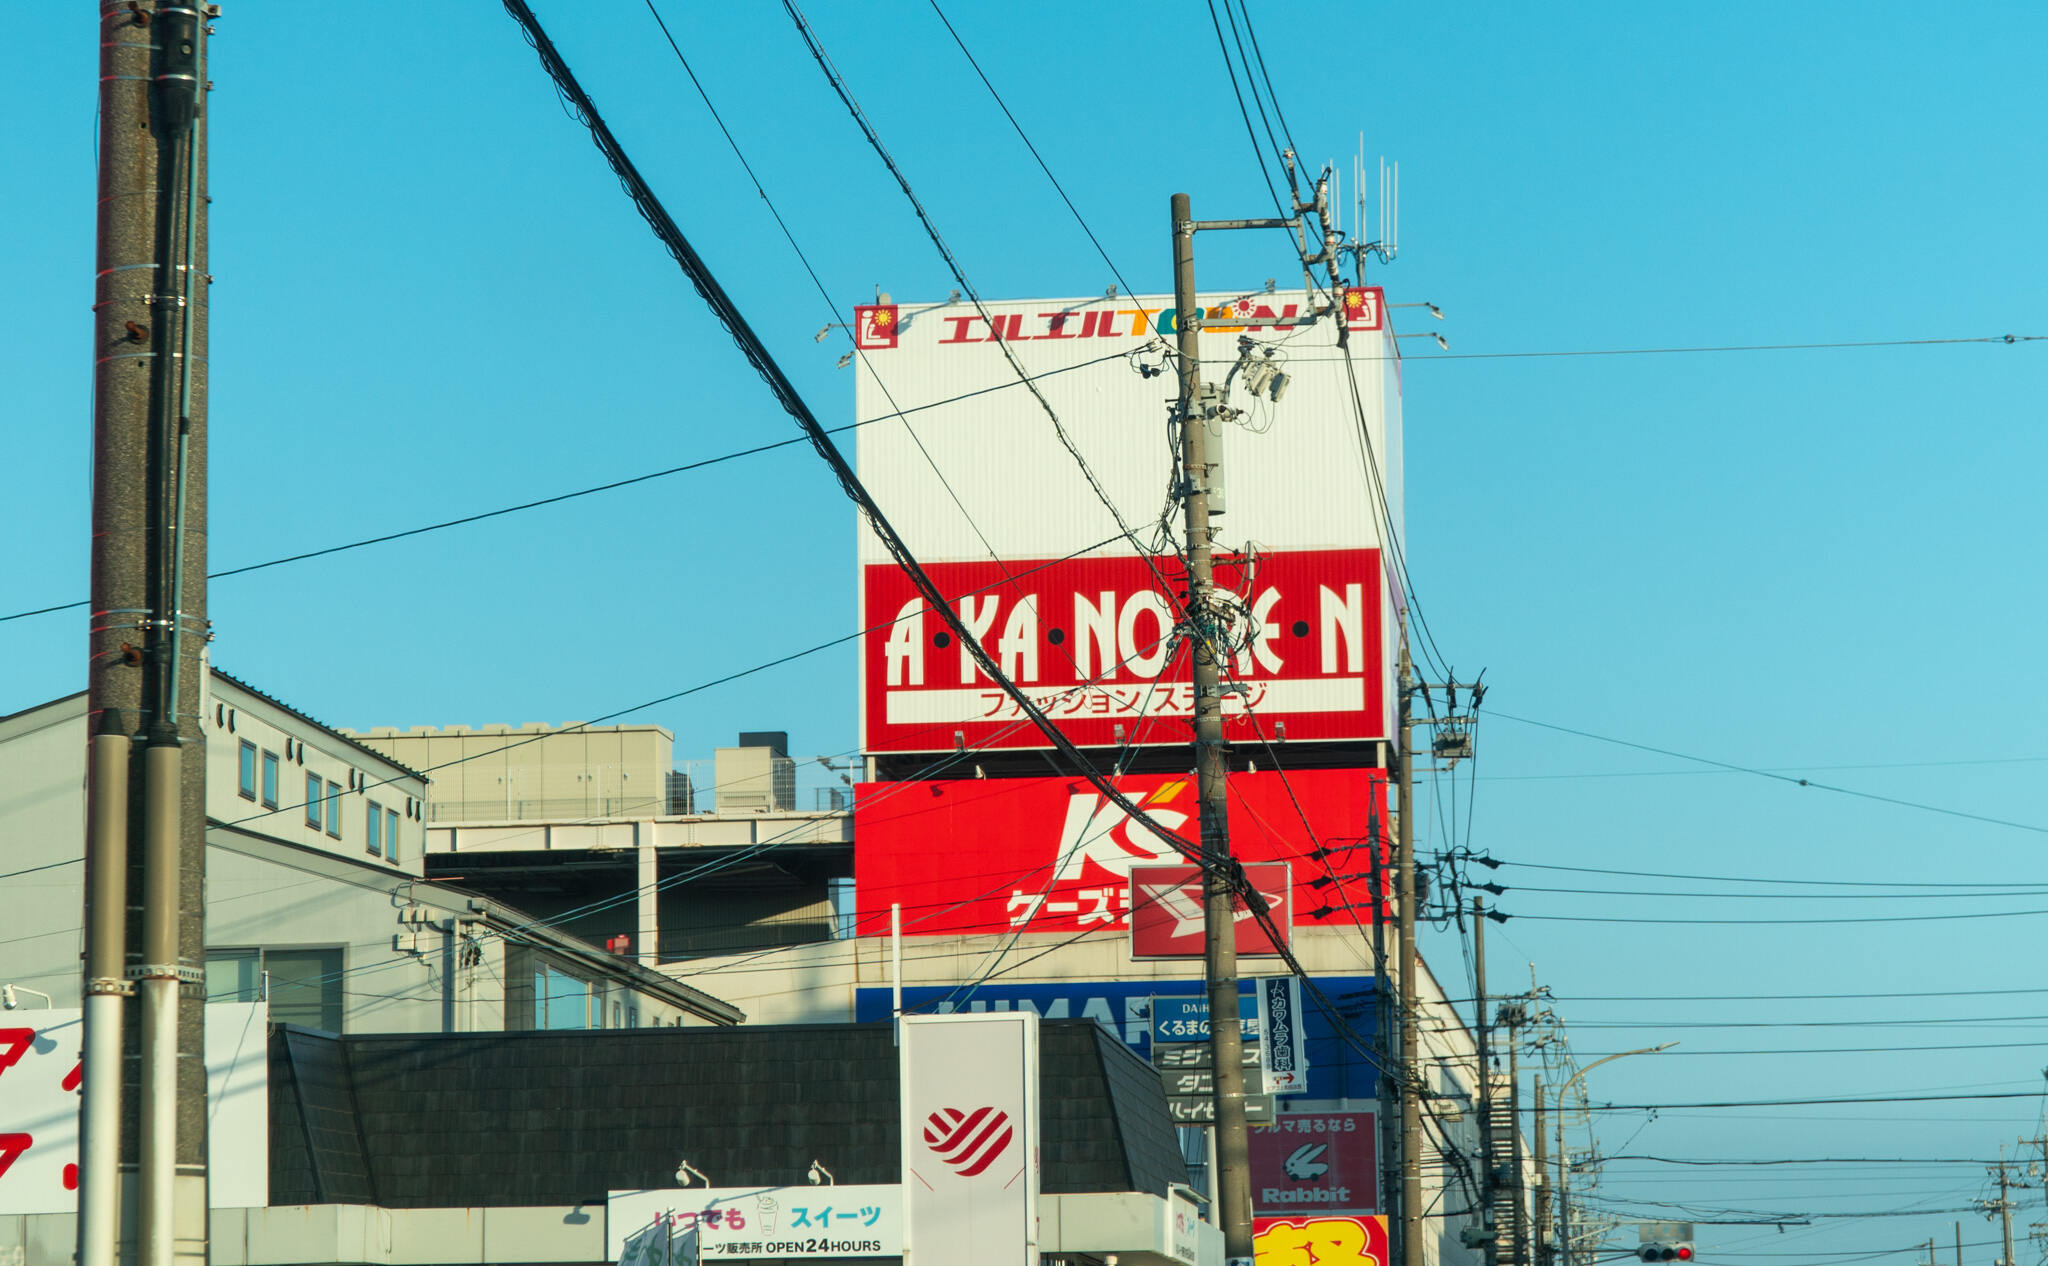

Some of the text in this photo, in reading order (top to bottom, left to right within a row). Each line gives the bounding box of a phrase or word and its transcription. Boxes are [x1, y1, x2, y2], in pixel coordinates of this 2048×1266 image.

[1006, 887, 1128, 927] ケーズ
[1271, 997, 1292, 1071] カワムラ歯科
[1262, 1186, 1351, 1204] Rabbit
[791, 1206, 882, 1229] スイーツ
[703, 1241, 762, 1254] ーツ販売所
